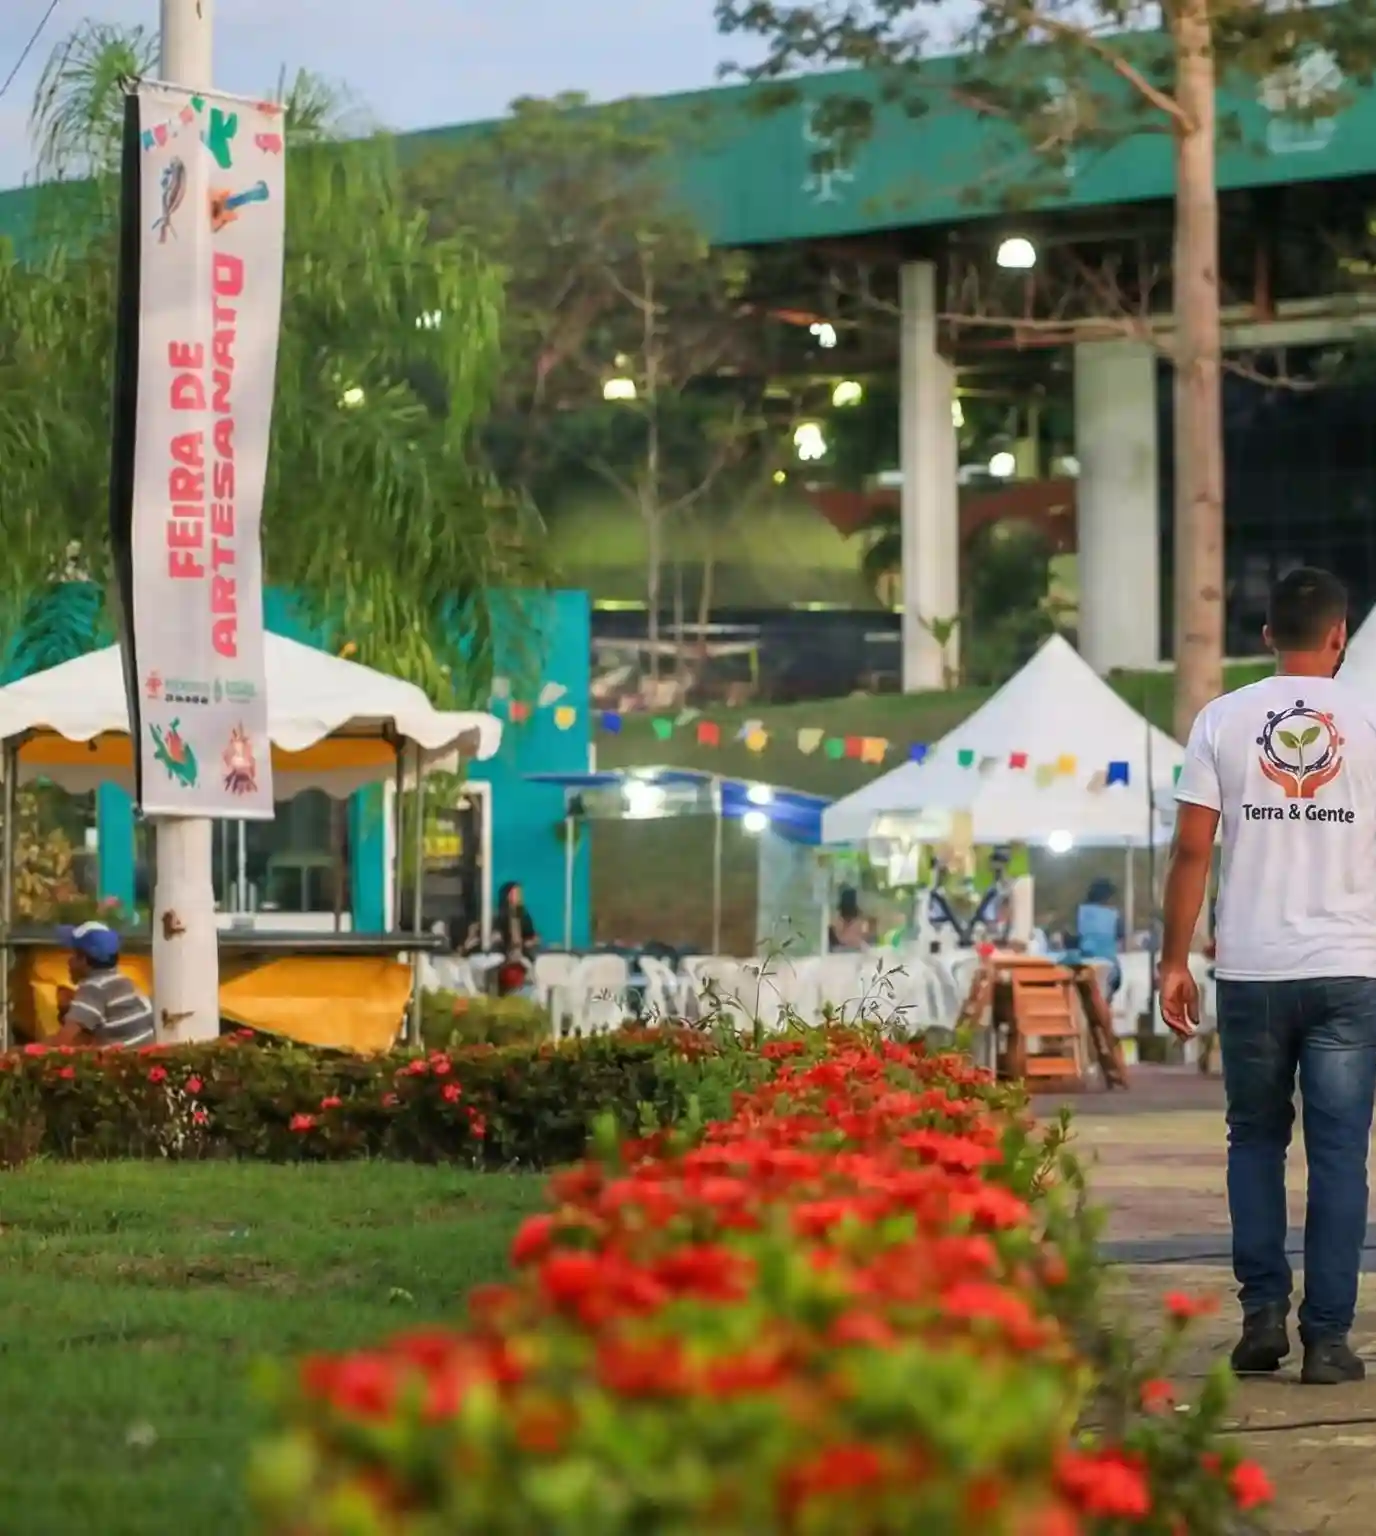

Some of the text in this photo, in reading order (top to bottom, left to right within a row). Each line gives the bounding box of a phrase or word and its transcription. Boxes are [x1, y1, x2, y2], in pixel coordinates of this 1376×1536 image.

[166, 340, 207, 579] FEIRA DE
[210, 251, 245, 658] ARTESANATO
[1242, 803, 1356, 824] Terra & Gente
